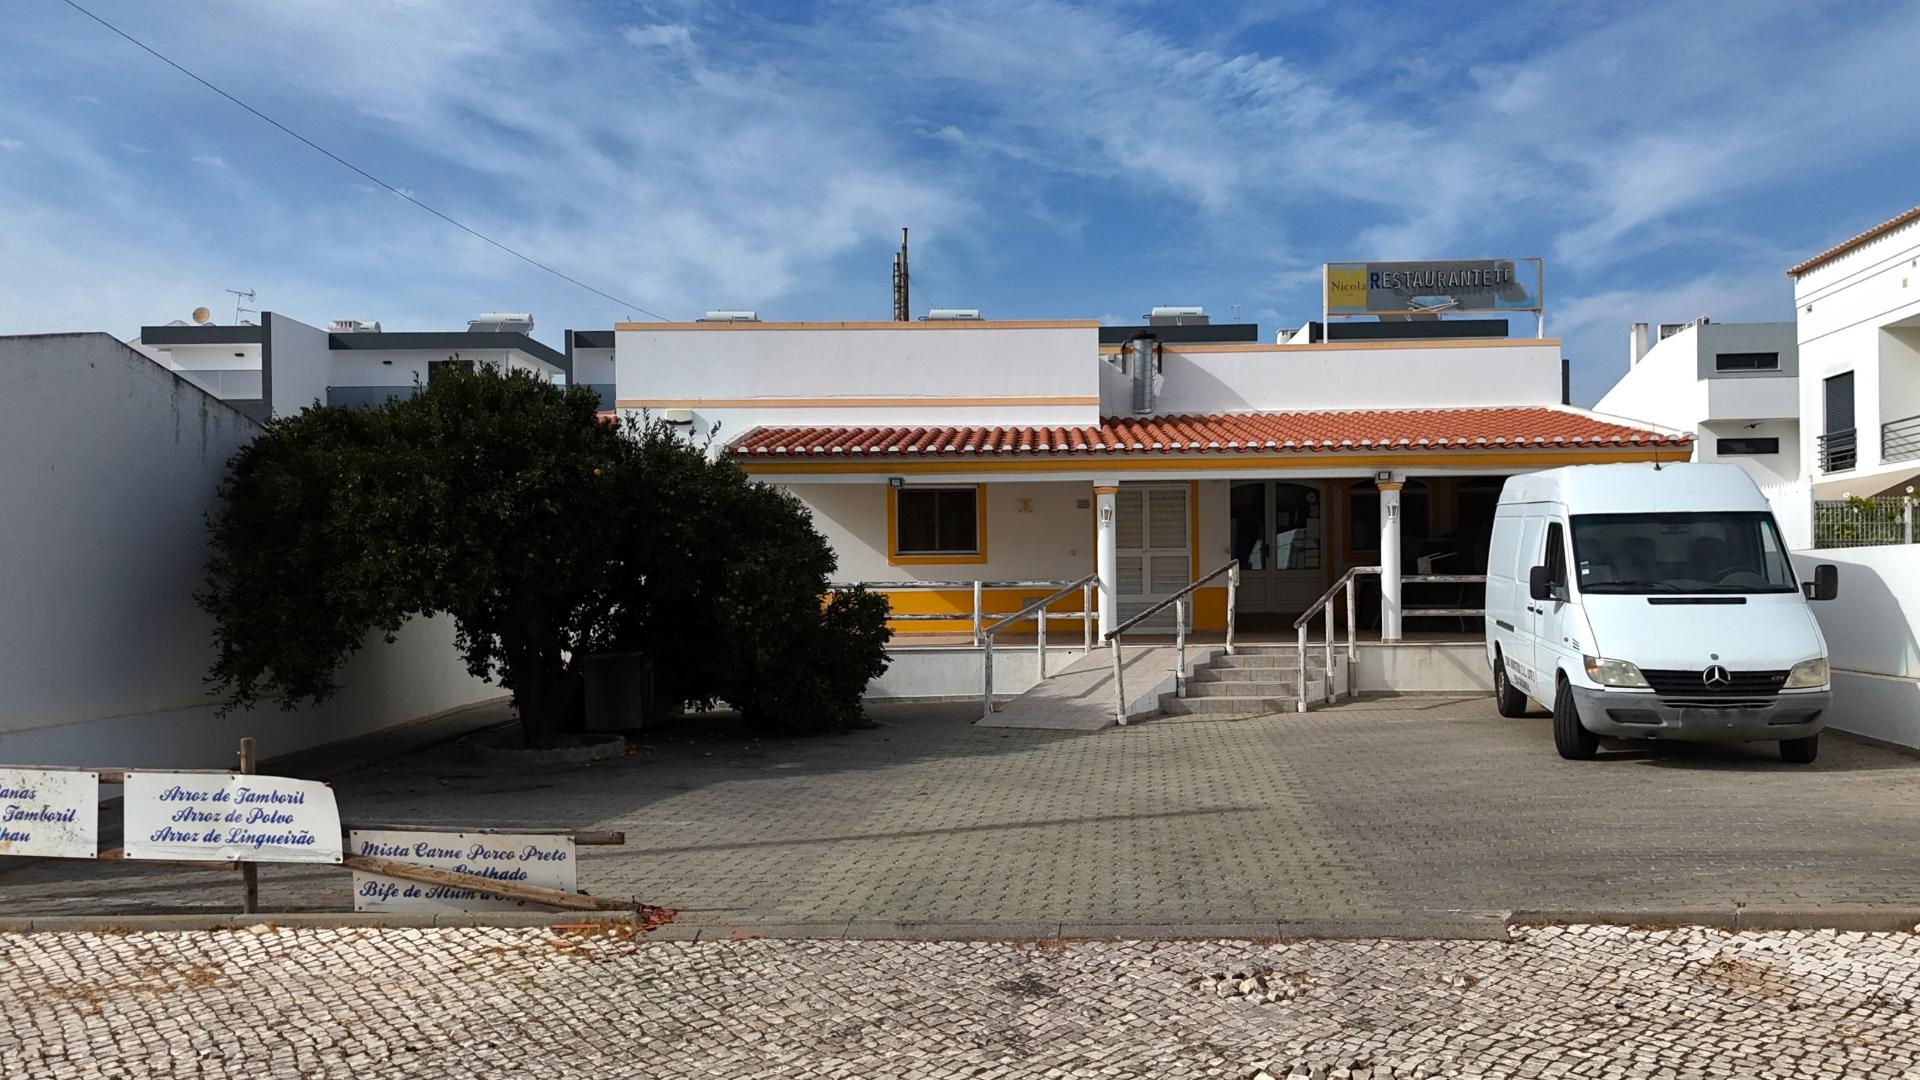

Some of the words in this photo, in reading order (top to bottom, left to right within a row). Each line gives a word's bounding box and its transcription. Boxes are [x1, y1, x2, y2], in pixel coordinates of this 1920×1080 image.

[1331, 280, 1366, 292] Nicola
[0, 785, 36, 799] anas
[159, 785, 208, 802] Arroz
[212, 788, 230, 802] de
[234, 787, 305, 805] Tamboril
[3, 804, 76, 822] Tamboril
[172, 806, 222, 823] Arroz
[224, 808, 242, 823] de
[246, 807, 294, 824] Polvo
[0, 827, 31, 842] hau
[150, 826, 200, 842] Arroz
[203, 828, 222, 843] de
[225, 827, 316, 850] Lingueirão
[361, 841, 410, 857] Mista
[413, 842, 463, 859] Carne
[466, 844, 515, 860] Porco
[519, 845, 567, 861] Preto
[359, 881, 399, 902] Bife
[403, 884, 422, 898] de
